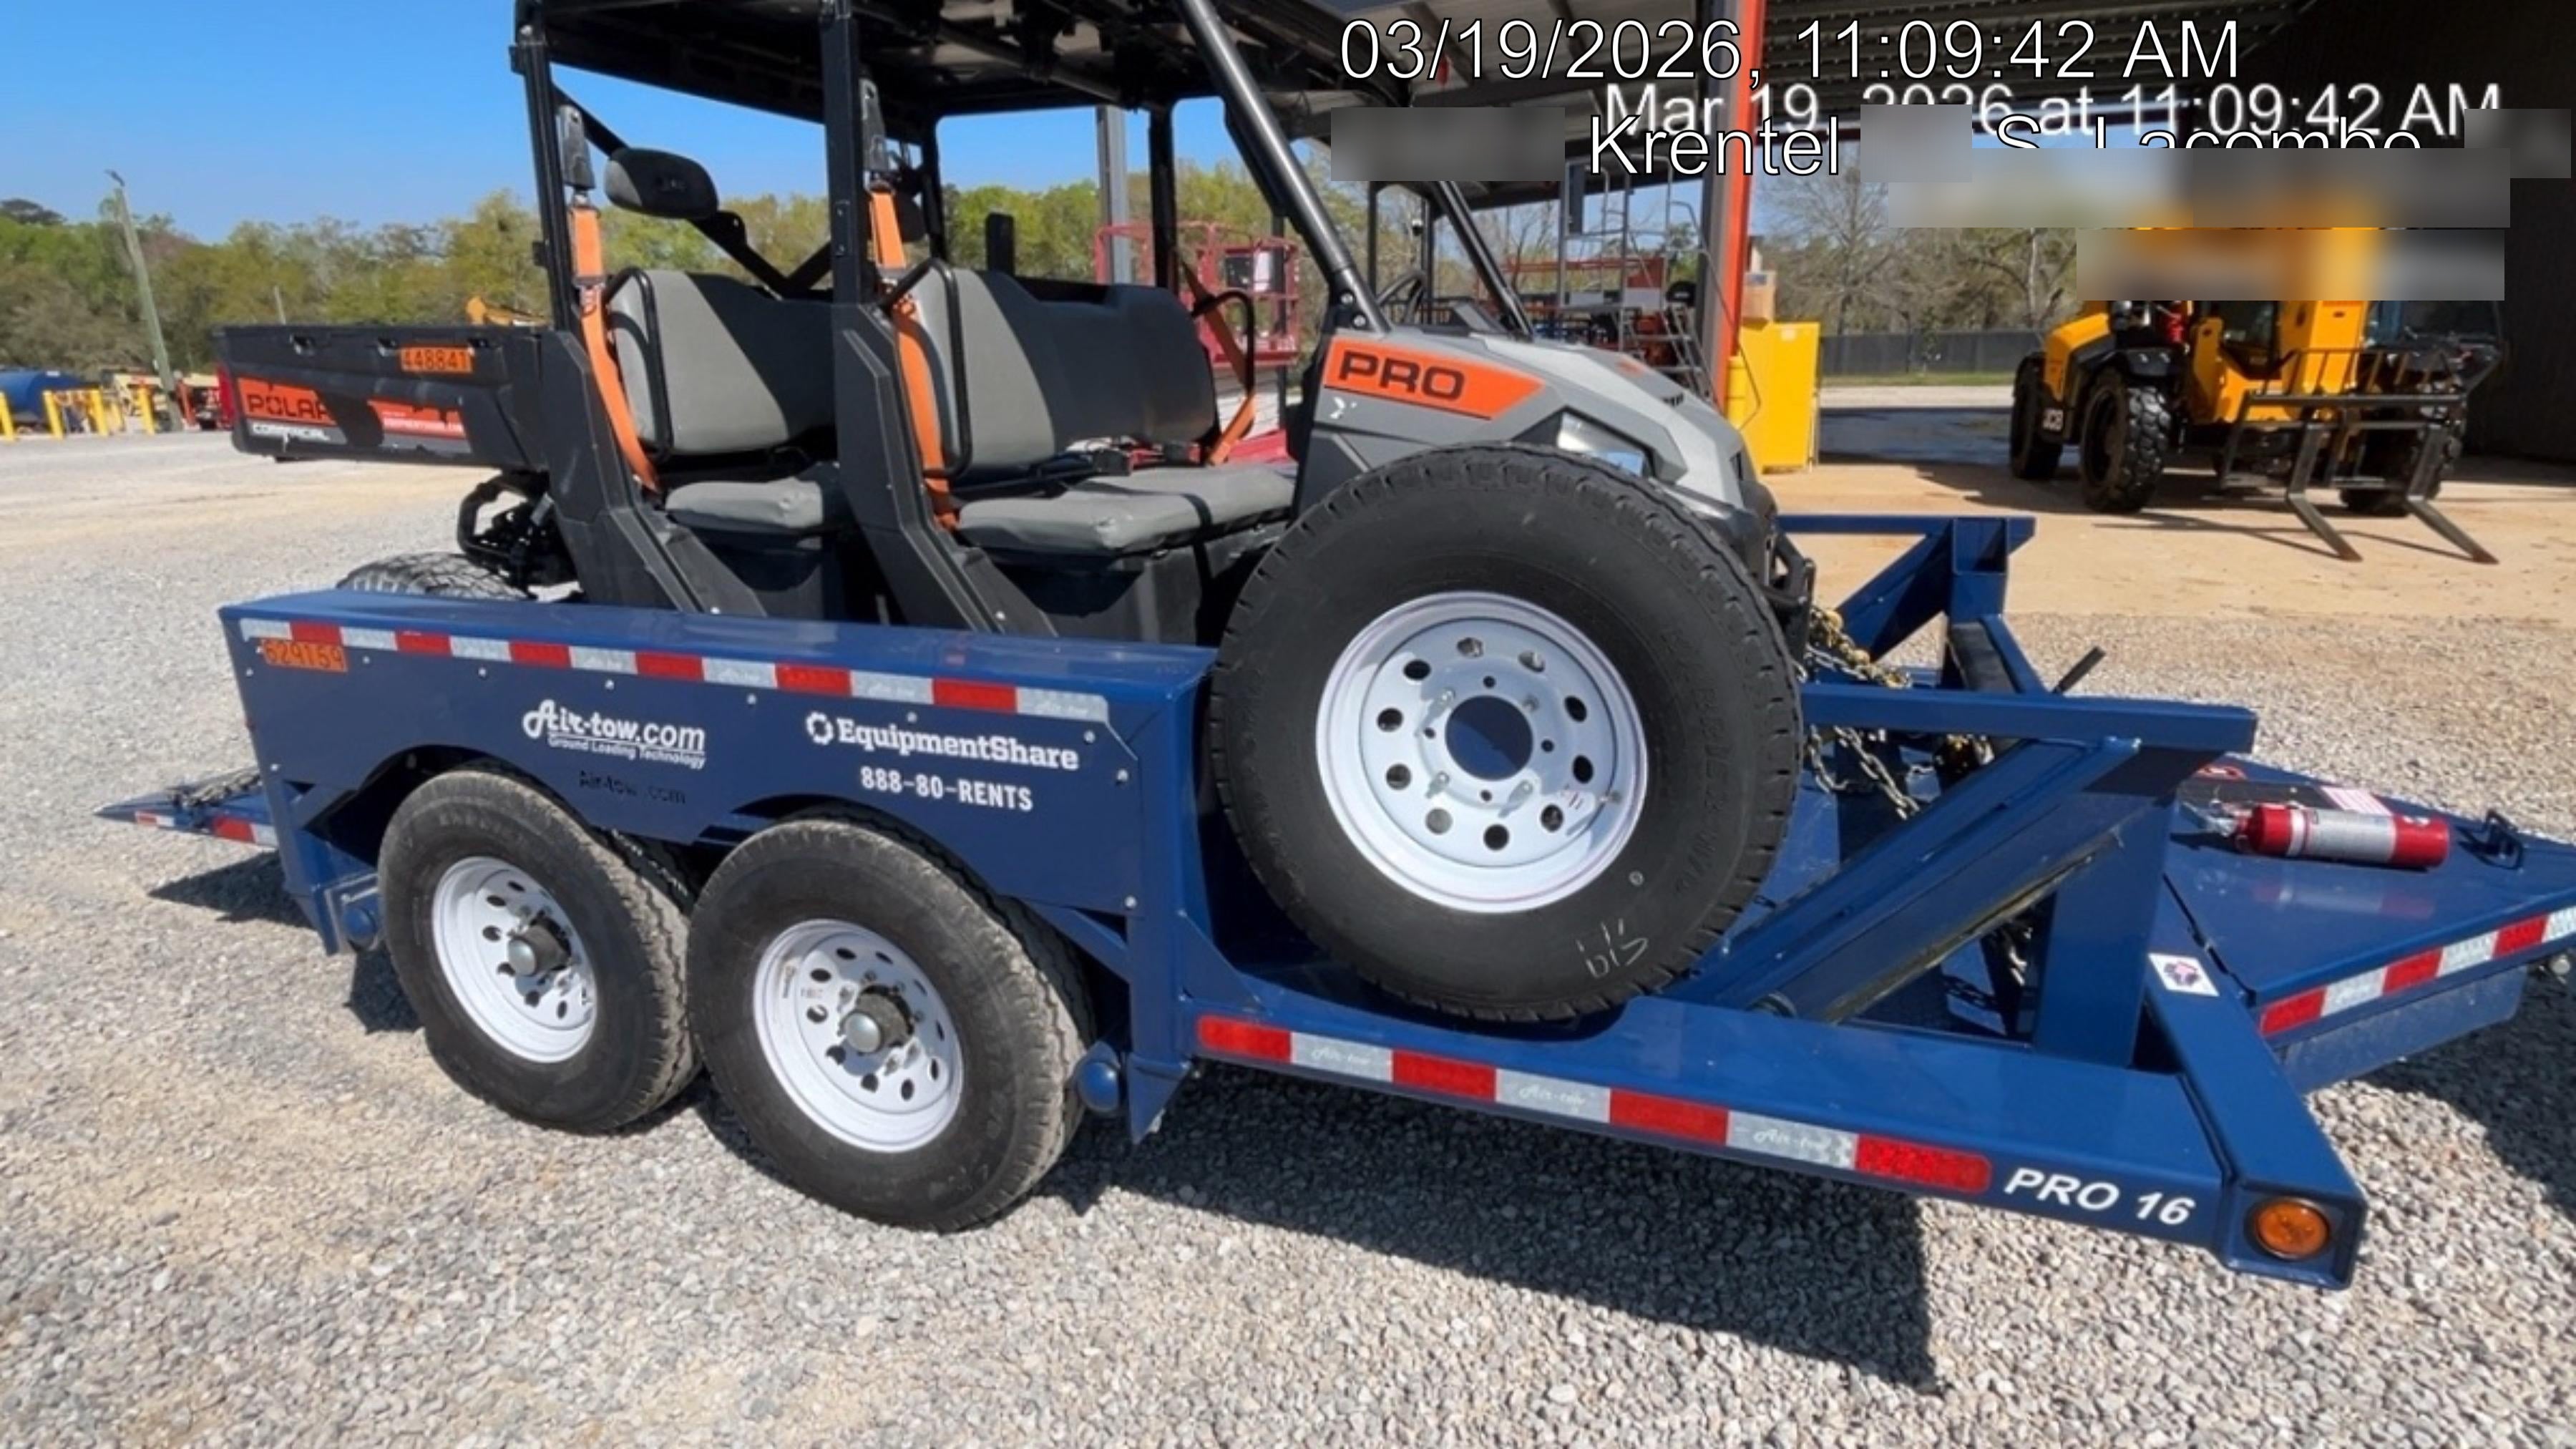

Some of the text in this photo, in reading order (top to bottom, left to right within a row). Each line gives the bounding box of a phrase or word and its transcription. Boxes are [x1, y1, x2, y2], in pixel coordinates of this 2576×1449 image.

[1338, 350, 1464, 400] PRO
[522, 699, 706, 751] Air-tow.com
[836, 718, 1080, 771] EquipmentShare
[860, 765, 1034, 812] 888-80-RENTS
[2004, 1166, 2195, 1226] PRO 16
